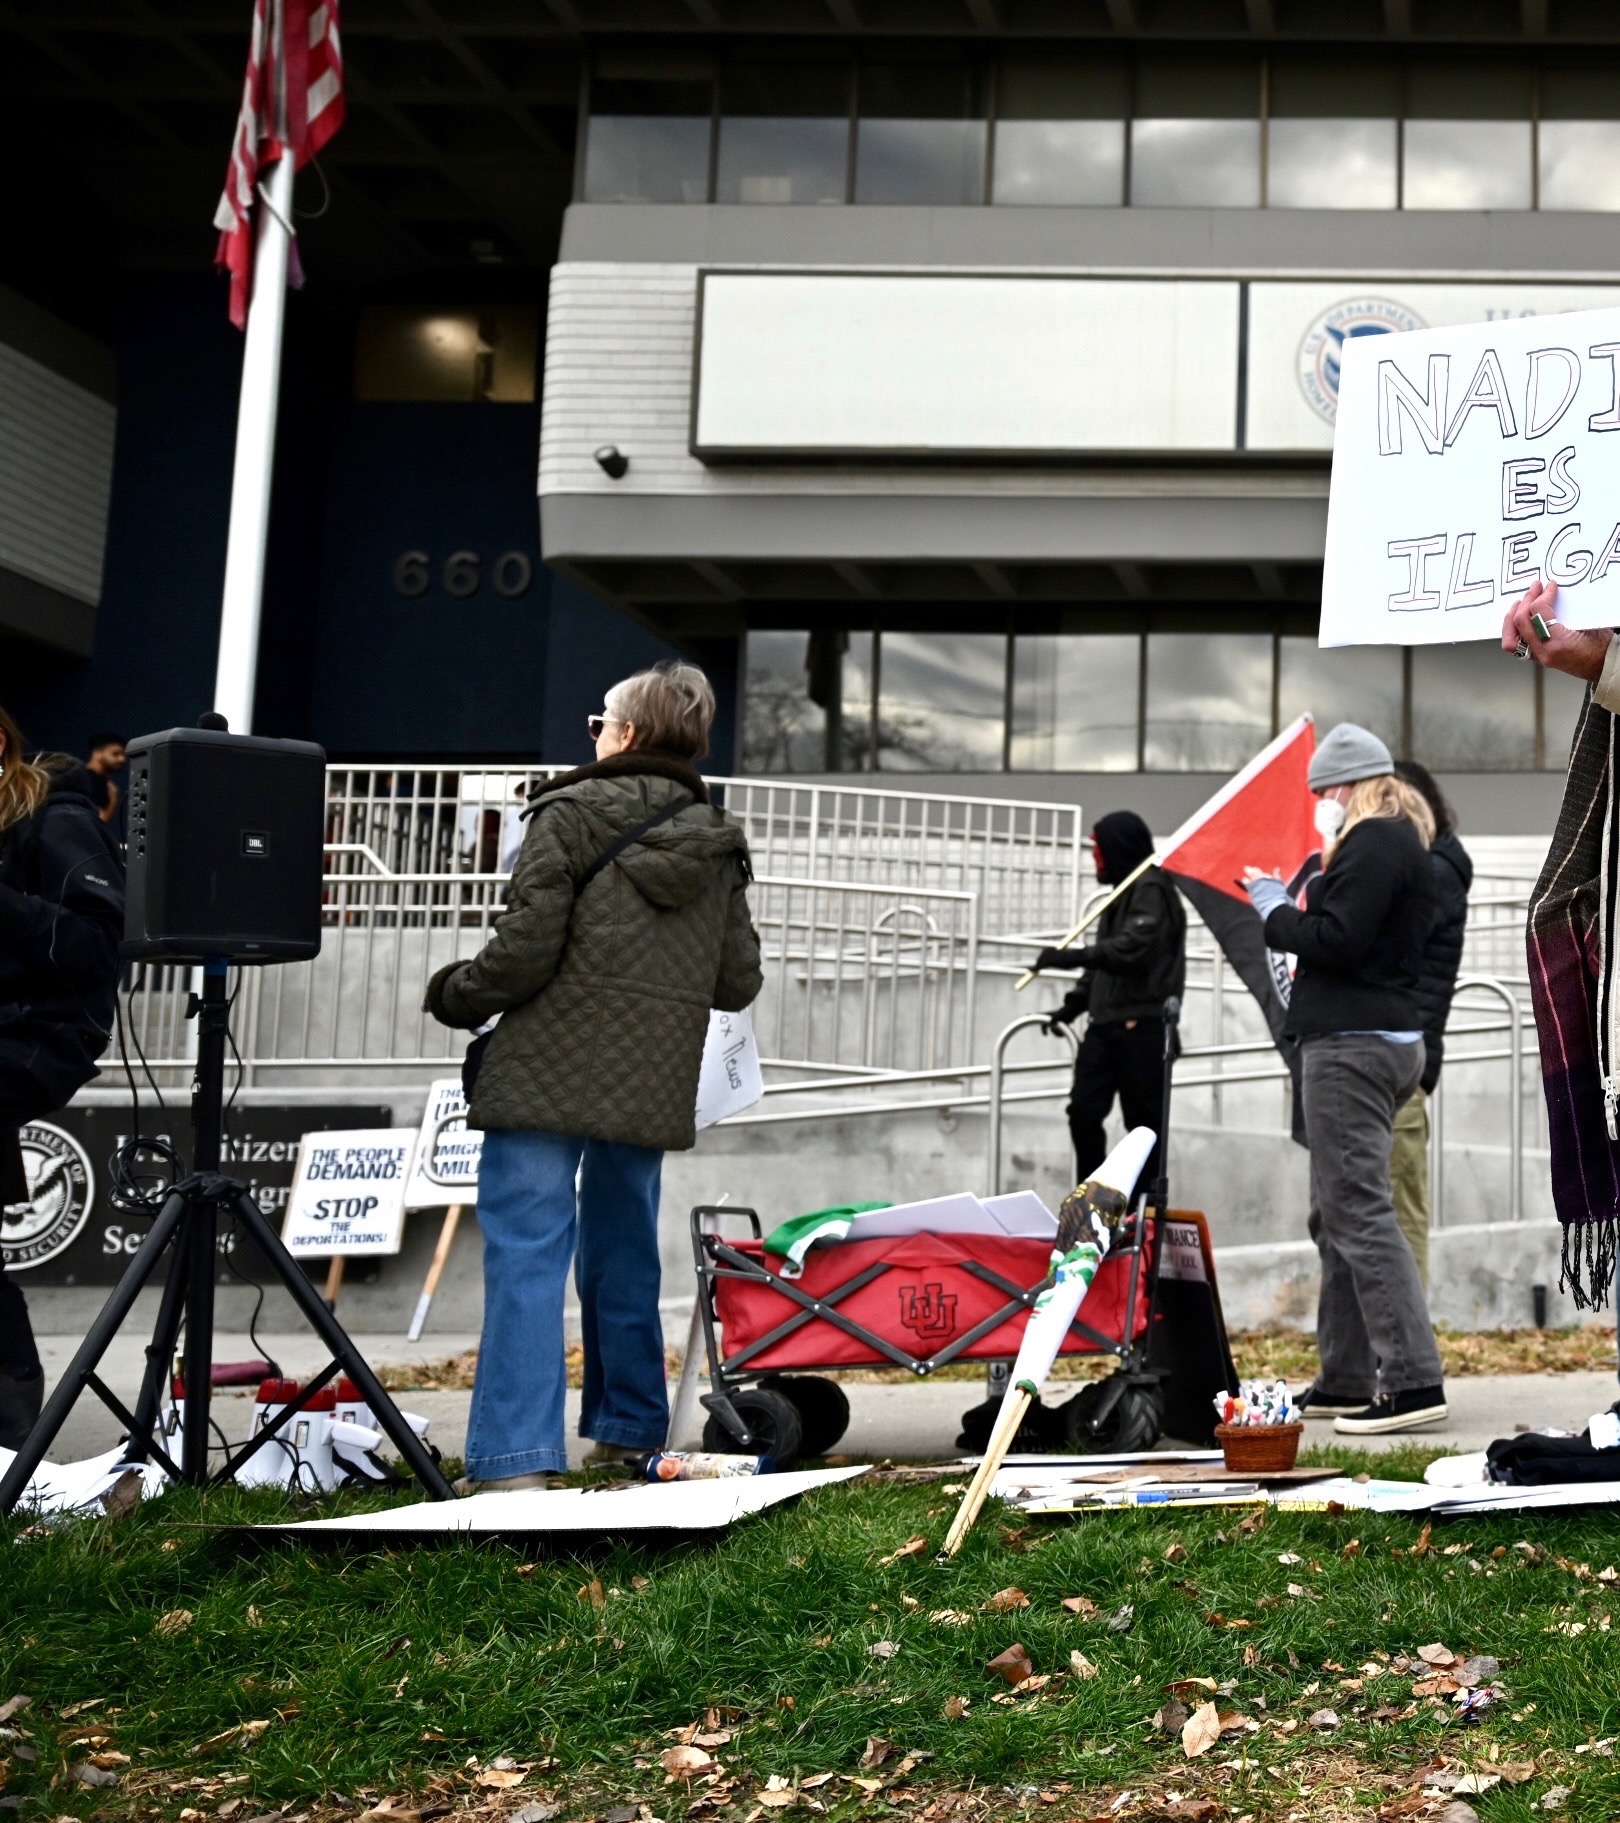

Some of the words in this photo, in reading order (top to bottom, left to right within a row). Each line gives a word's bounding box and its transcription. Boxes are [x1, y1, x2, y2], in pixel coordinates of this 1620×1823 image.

[1502, 446, 1580, 521] ES
[394, 551, 532, 596] 660
[19, 1127, 78, 1163] RTMENT
[220, 1133, 300, 1163] itizen
[311, 1149, 341, 1164] THE
[344, 1147, 407, 1163] PEOPLE
[306, 1161, 403, 1181] DEMAND:
[313, 1196, 379, 1221] STOP
[330, 1221, 351, 1233] THE
